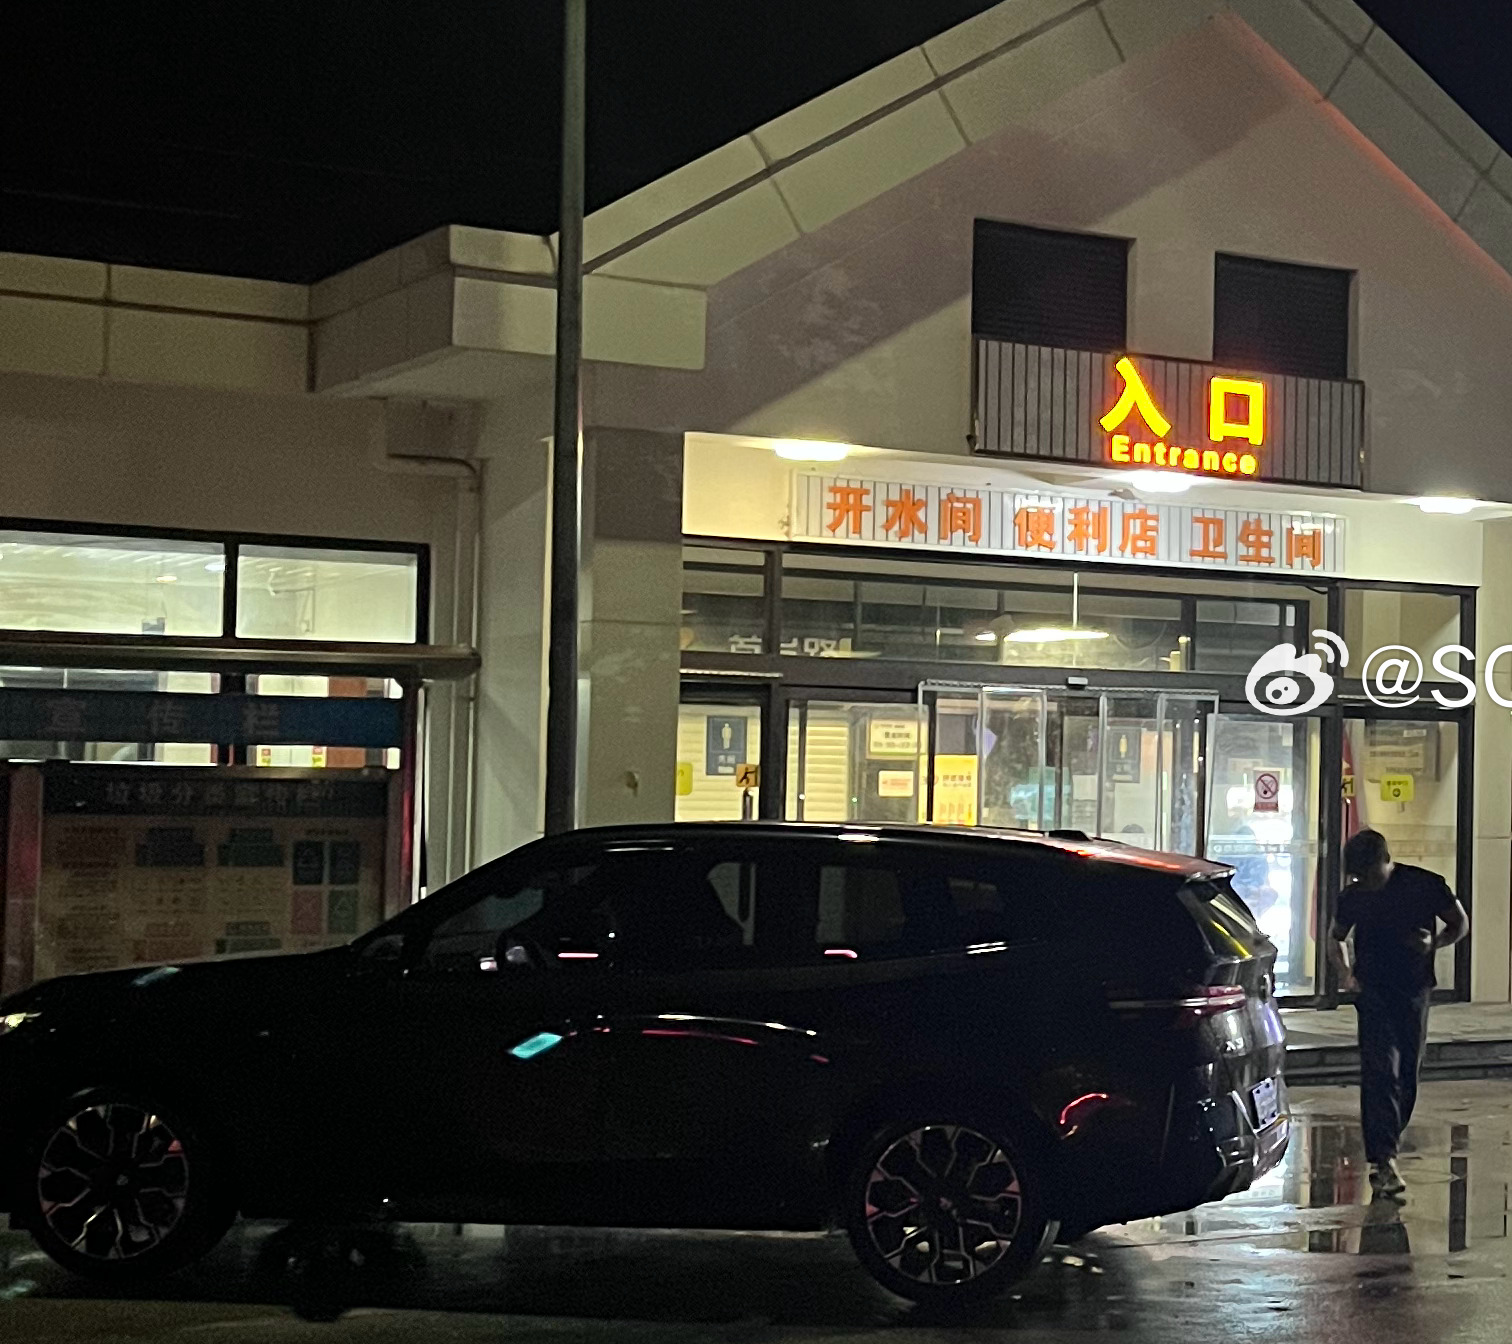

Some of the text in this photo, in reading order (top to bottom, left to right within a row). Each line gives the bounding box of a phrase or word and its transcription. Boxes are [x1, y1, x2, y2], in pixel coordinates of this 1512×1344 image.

[1099, 357, 1264, 446] 入口
[1111, 433, 1258, 475] Entrance
[826, 485, 1323, 568] 开水间 便利店 卫生间
